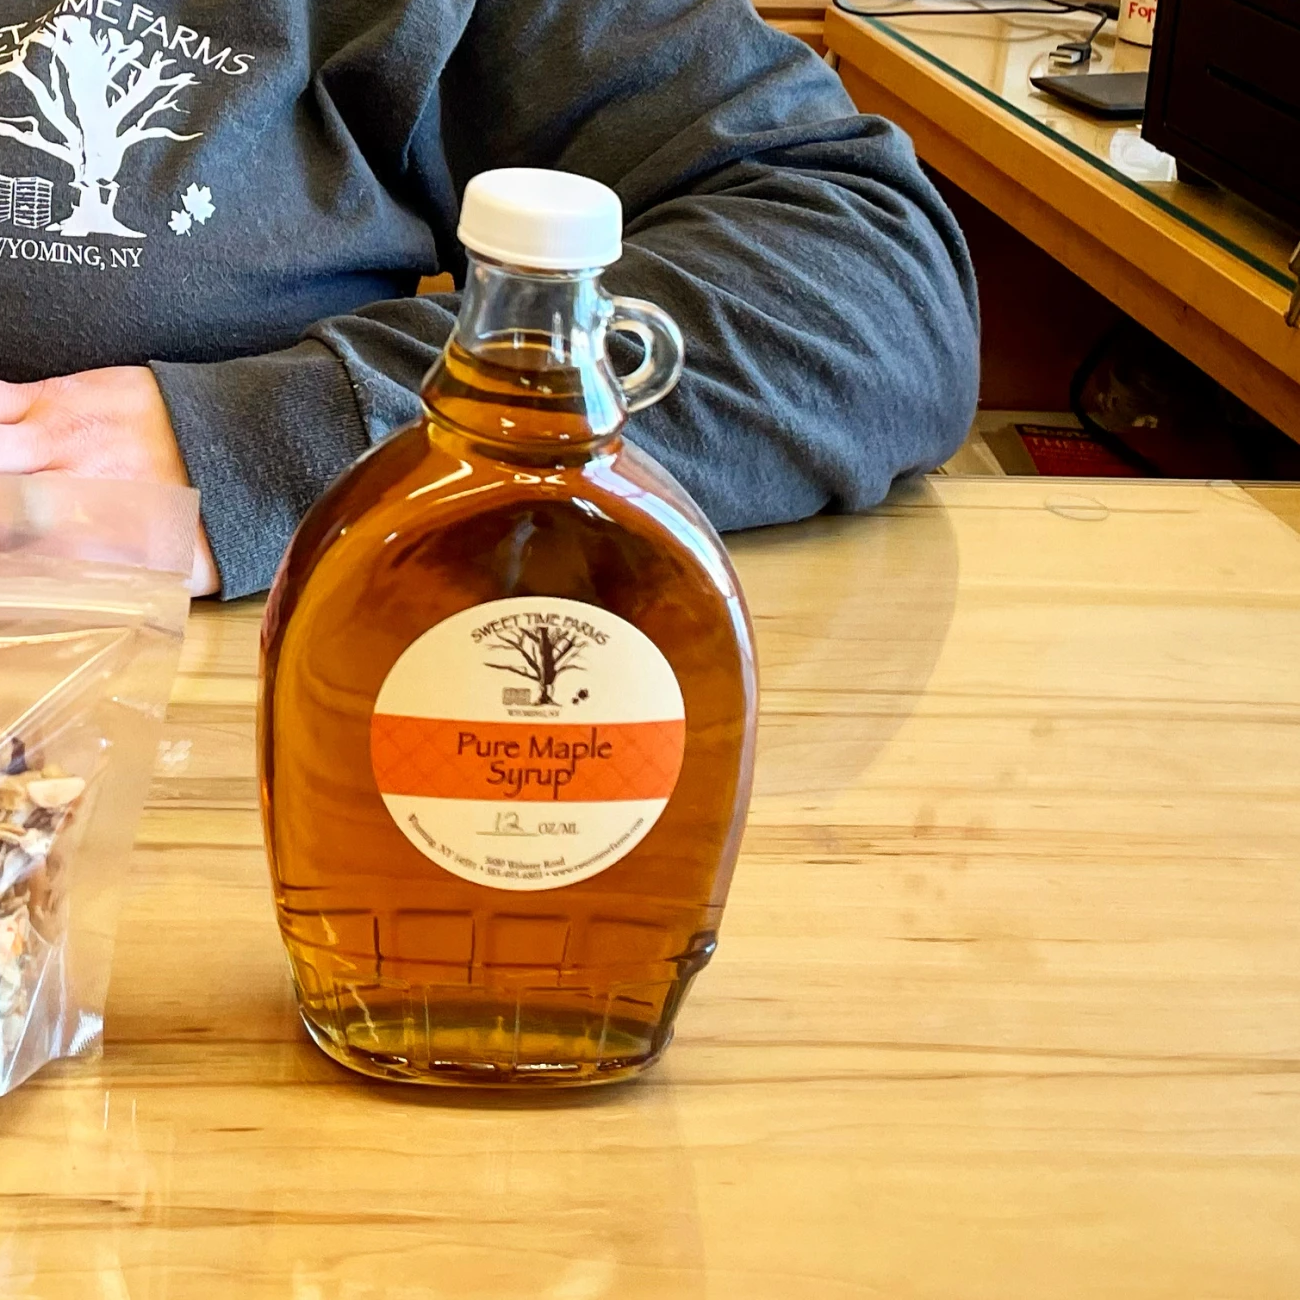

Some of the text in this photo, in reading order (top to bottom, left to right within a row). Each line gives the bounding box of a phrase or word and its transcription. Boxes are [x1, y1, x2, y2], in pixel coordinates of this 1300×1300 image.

[127, 3, 255, 75] FARMS
[110, 247, 143, 268] NY
[471, 612, 611, 646] SWEET TIME FARMS
[457, 726, 612, 774] Pure Maple
[487, 760, 574, 800] Syrup
[494, 811, 524, 832] 12
[538, 821, 580, 836] OZ/ML
